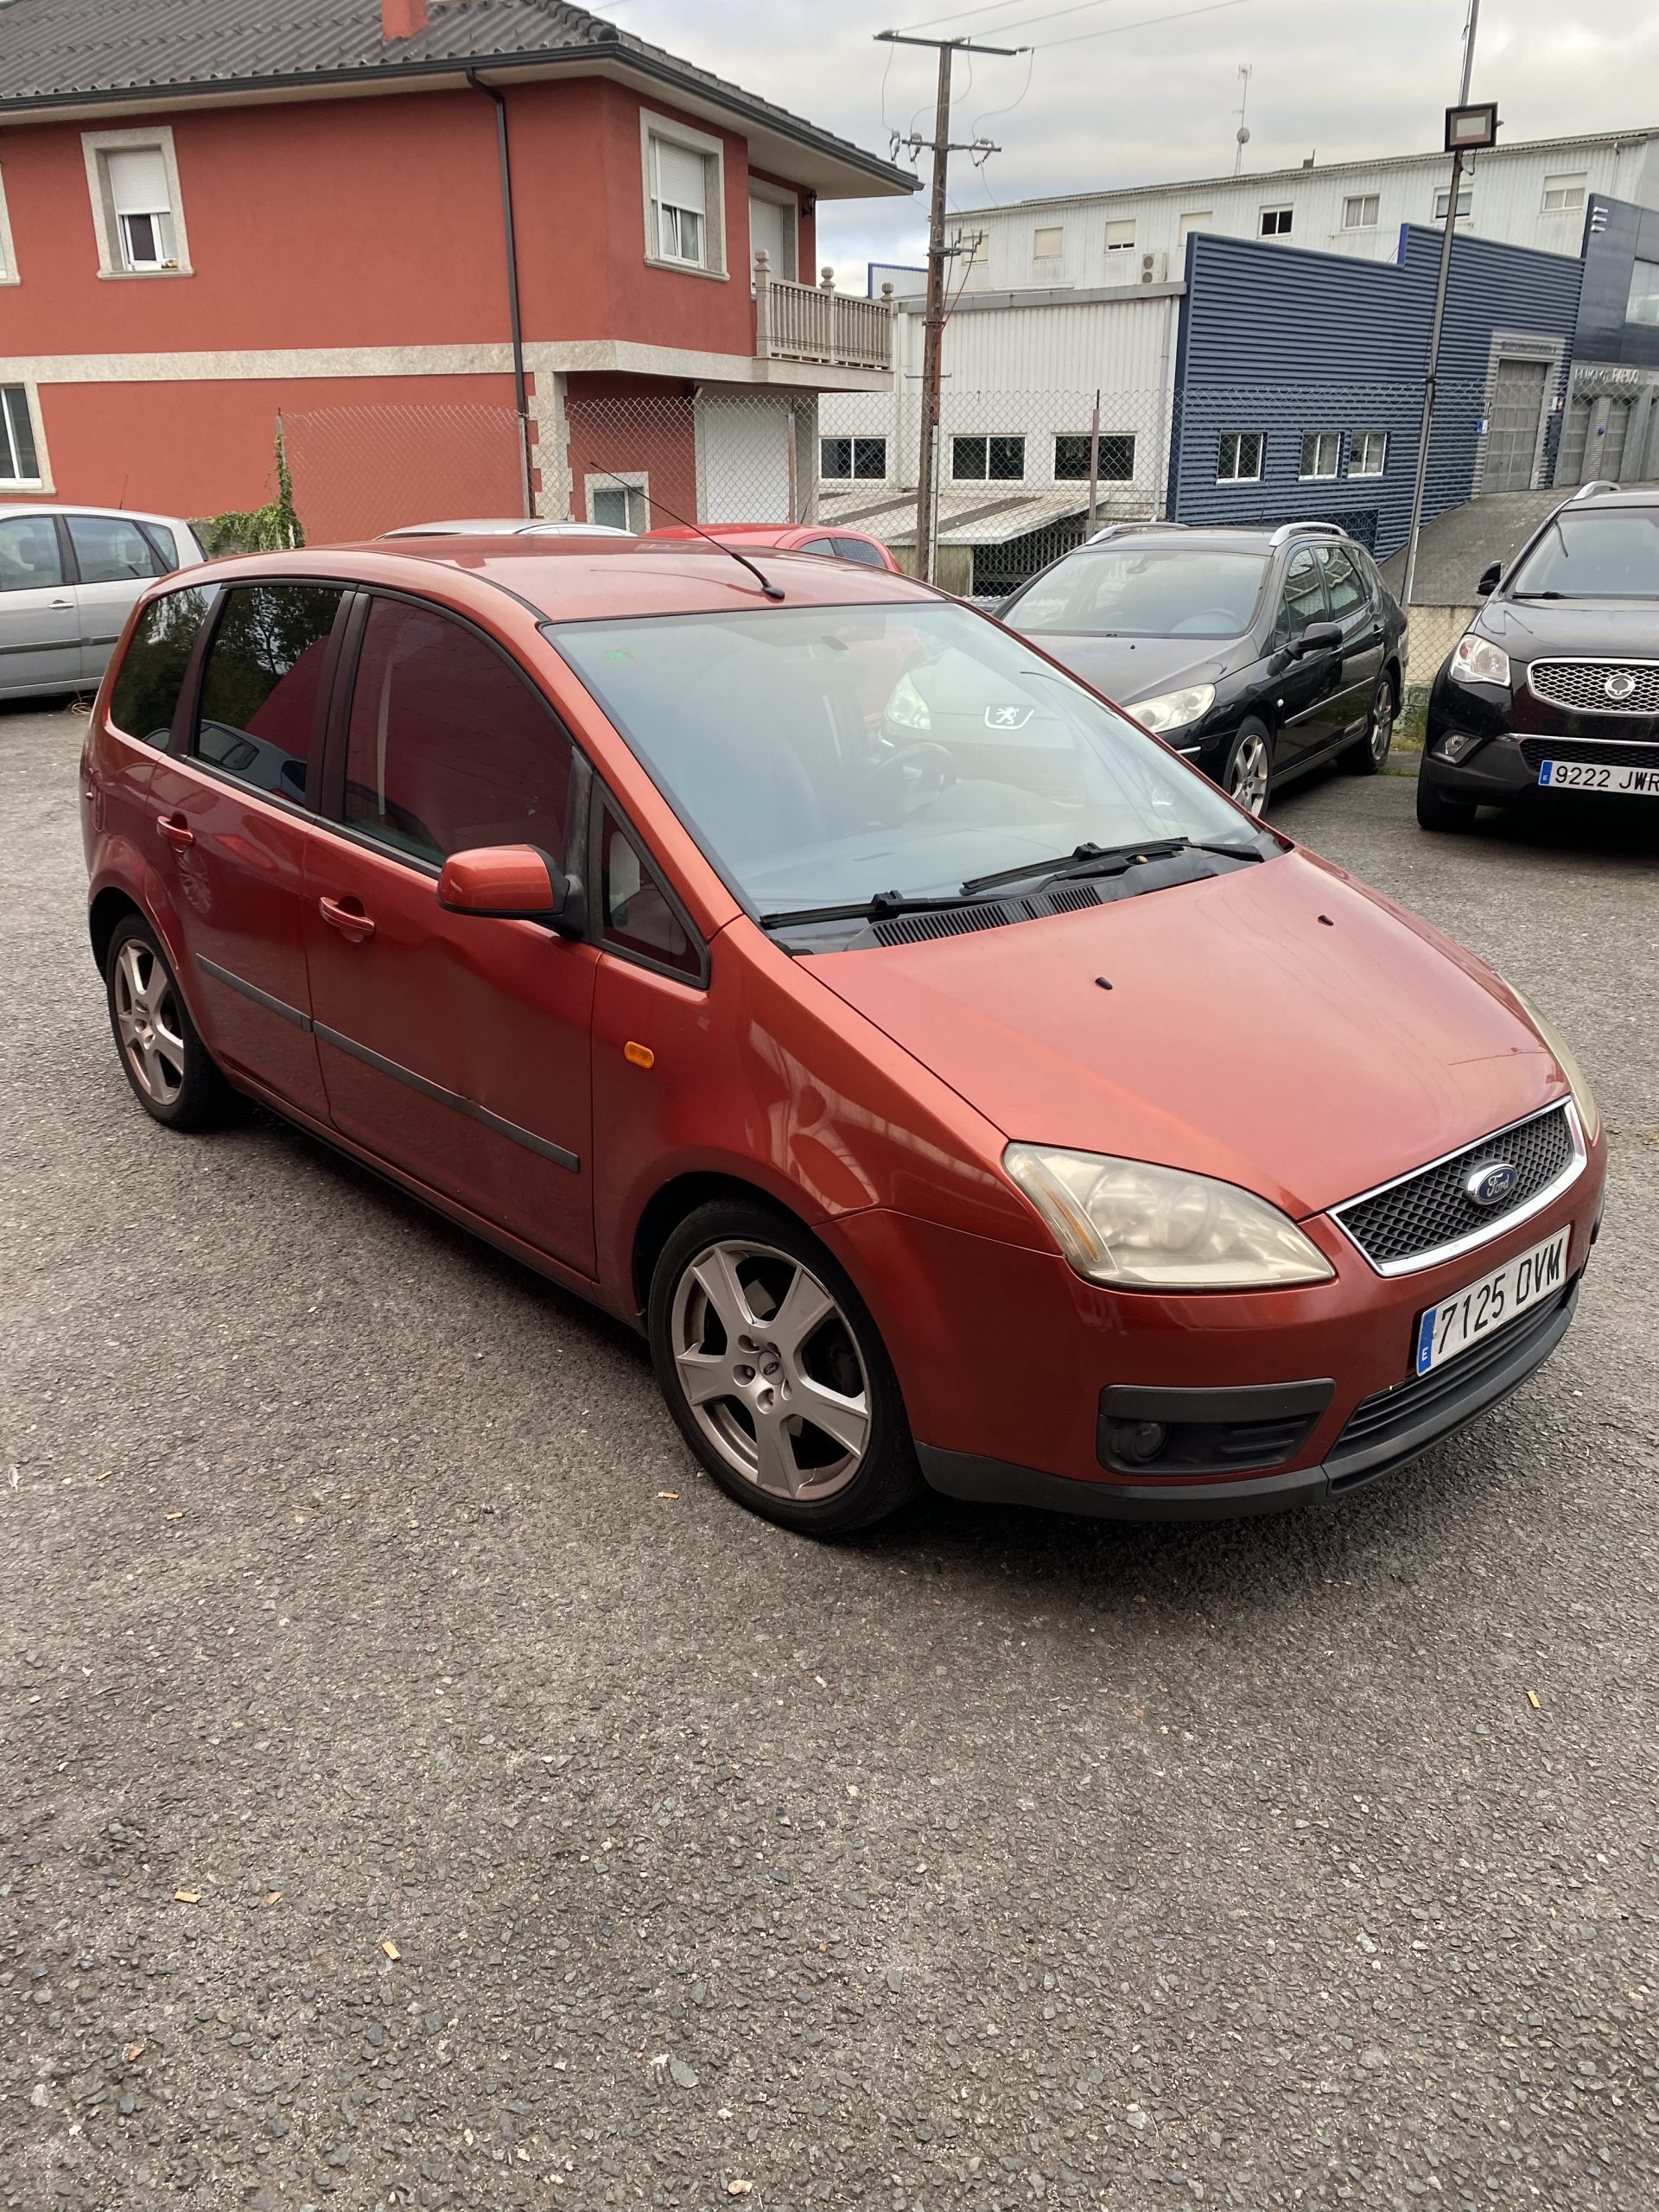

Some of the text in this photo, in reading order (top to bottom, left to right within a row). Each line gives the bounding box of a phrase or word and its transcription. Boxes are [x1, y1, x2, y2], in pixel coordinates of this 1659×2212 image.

[1555, 765, 1659, 792] 9222 JWR
[1487, 1172, 1510, 1198] Ford
[1438, 1237, 1563, 1355] 7125 DVM
[1421, 1346, 1429, 1362] E
